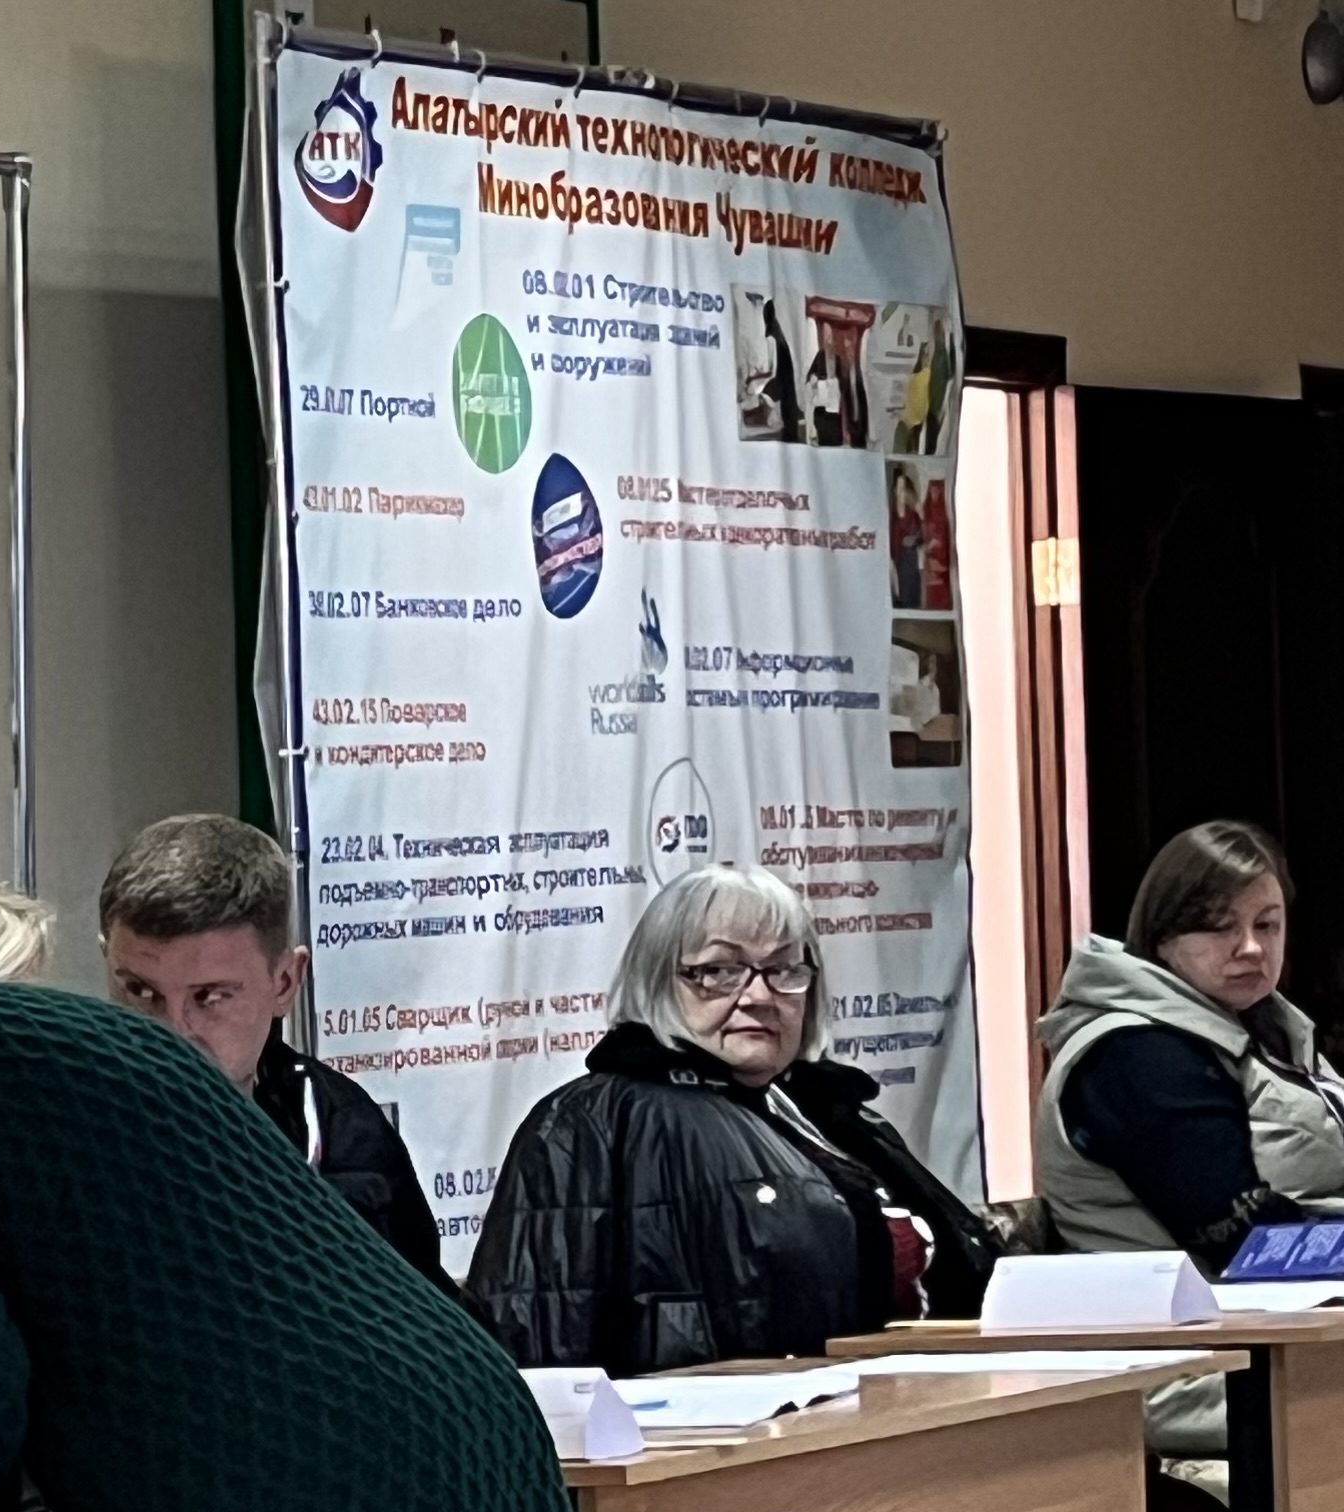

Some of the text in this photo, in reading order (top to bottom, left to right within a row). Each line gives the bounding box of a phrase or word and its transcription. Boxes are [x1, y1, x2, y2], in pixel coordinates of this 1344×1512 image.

[392, 76, 571, 154] Алатырский
[576, 113, 820, 184] технологический
[716, 191, 839, 256] Чувашии
[472, 598, 522, 623] дело
